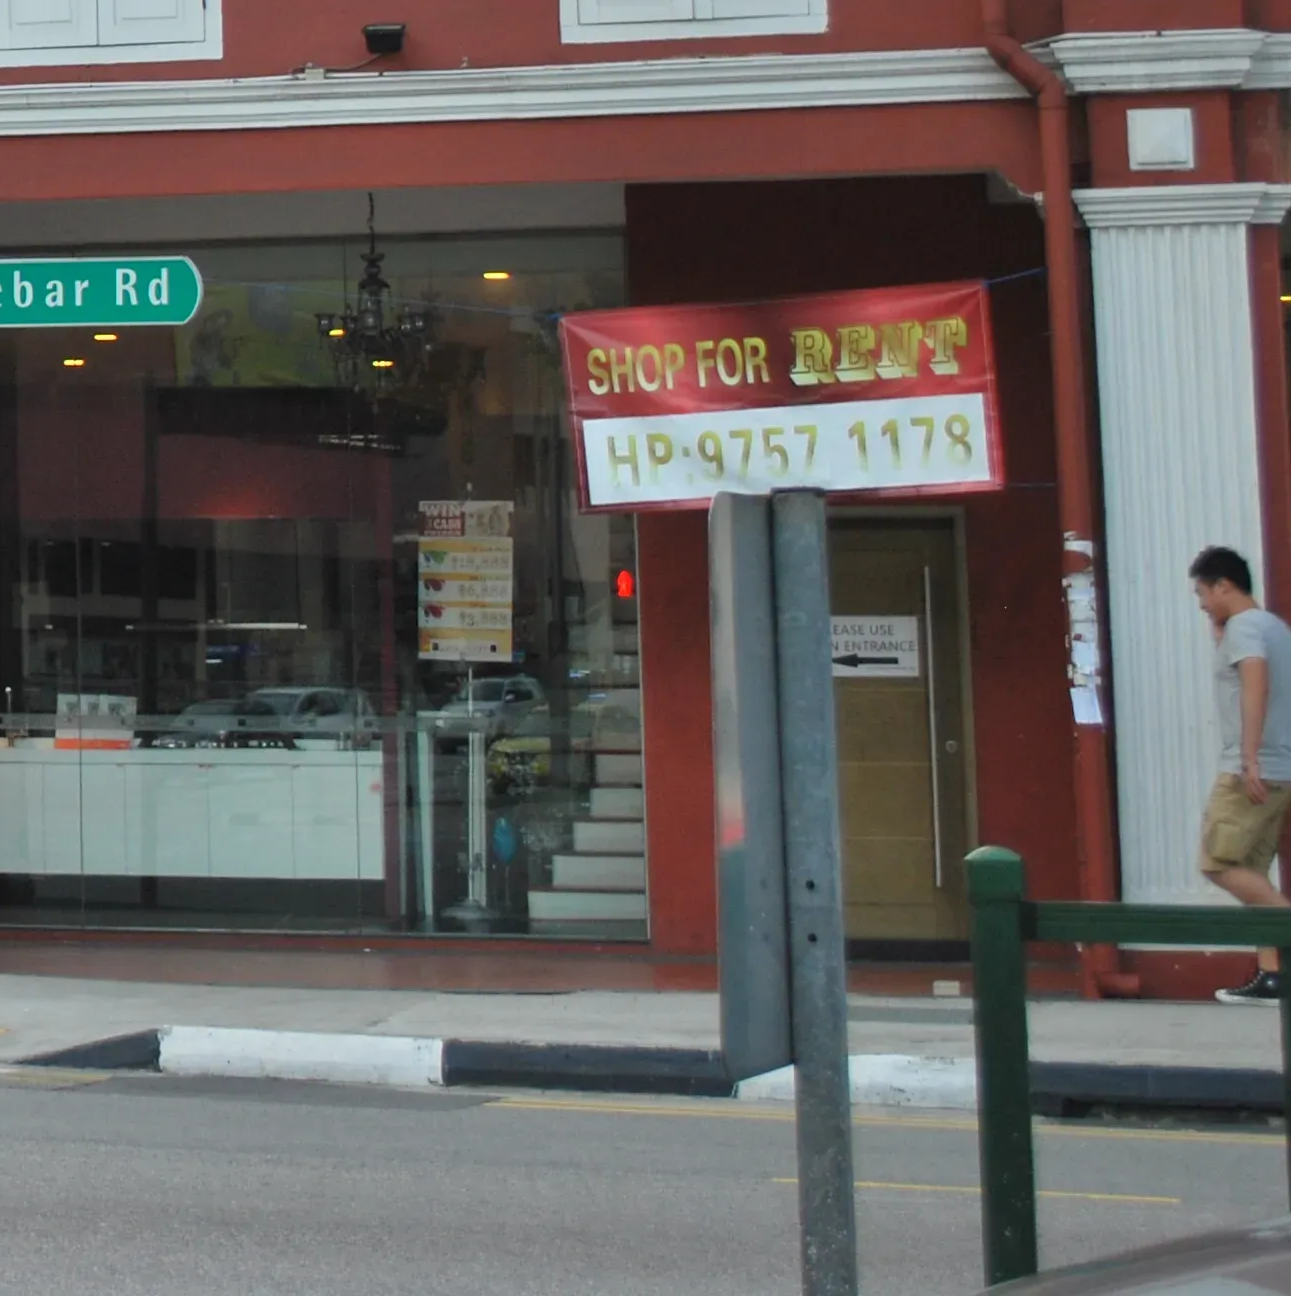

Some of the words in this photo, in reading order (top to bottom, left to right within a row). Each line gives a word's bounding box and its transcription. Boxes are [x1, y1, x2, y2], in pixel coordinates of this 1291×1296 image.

[115, 267, 171, 307] Rd
[587, 343, 686, 395] SHOP
[695, 336, 771, 388] FOR
[789, 316, 968, 387] RENT
[607, 422, 819, 487] HP:9757
[846, 413, 974, 475] 1178
[832, 623, 866, 636] EASE
[869, 624, 896, 636] USE
[843, 639, 916, 652] ENTRANCE
